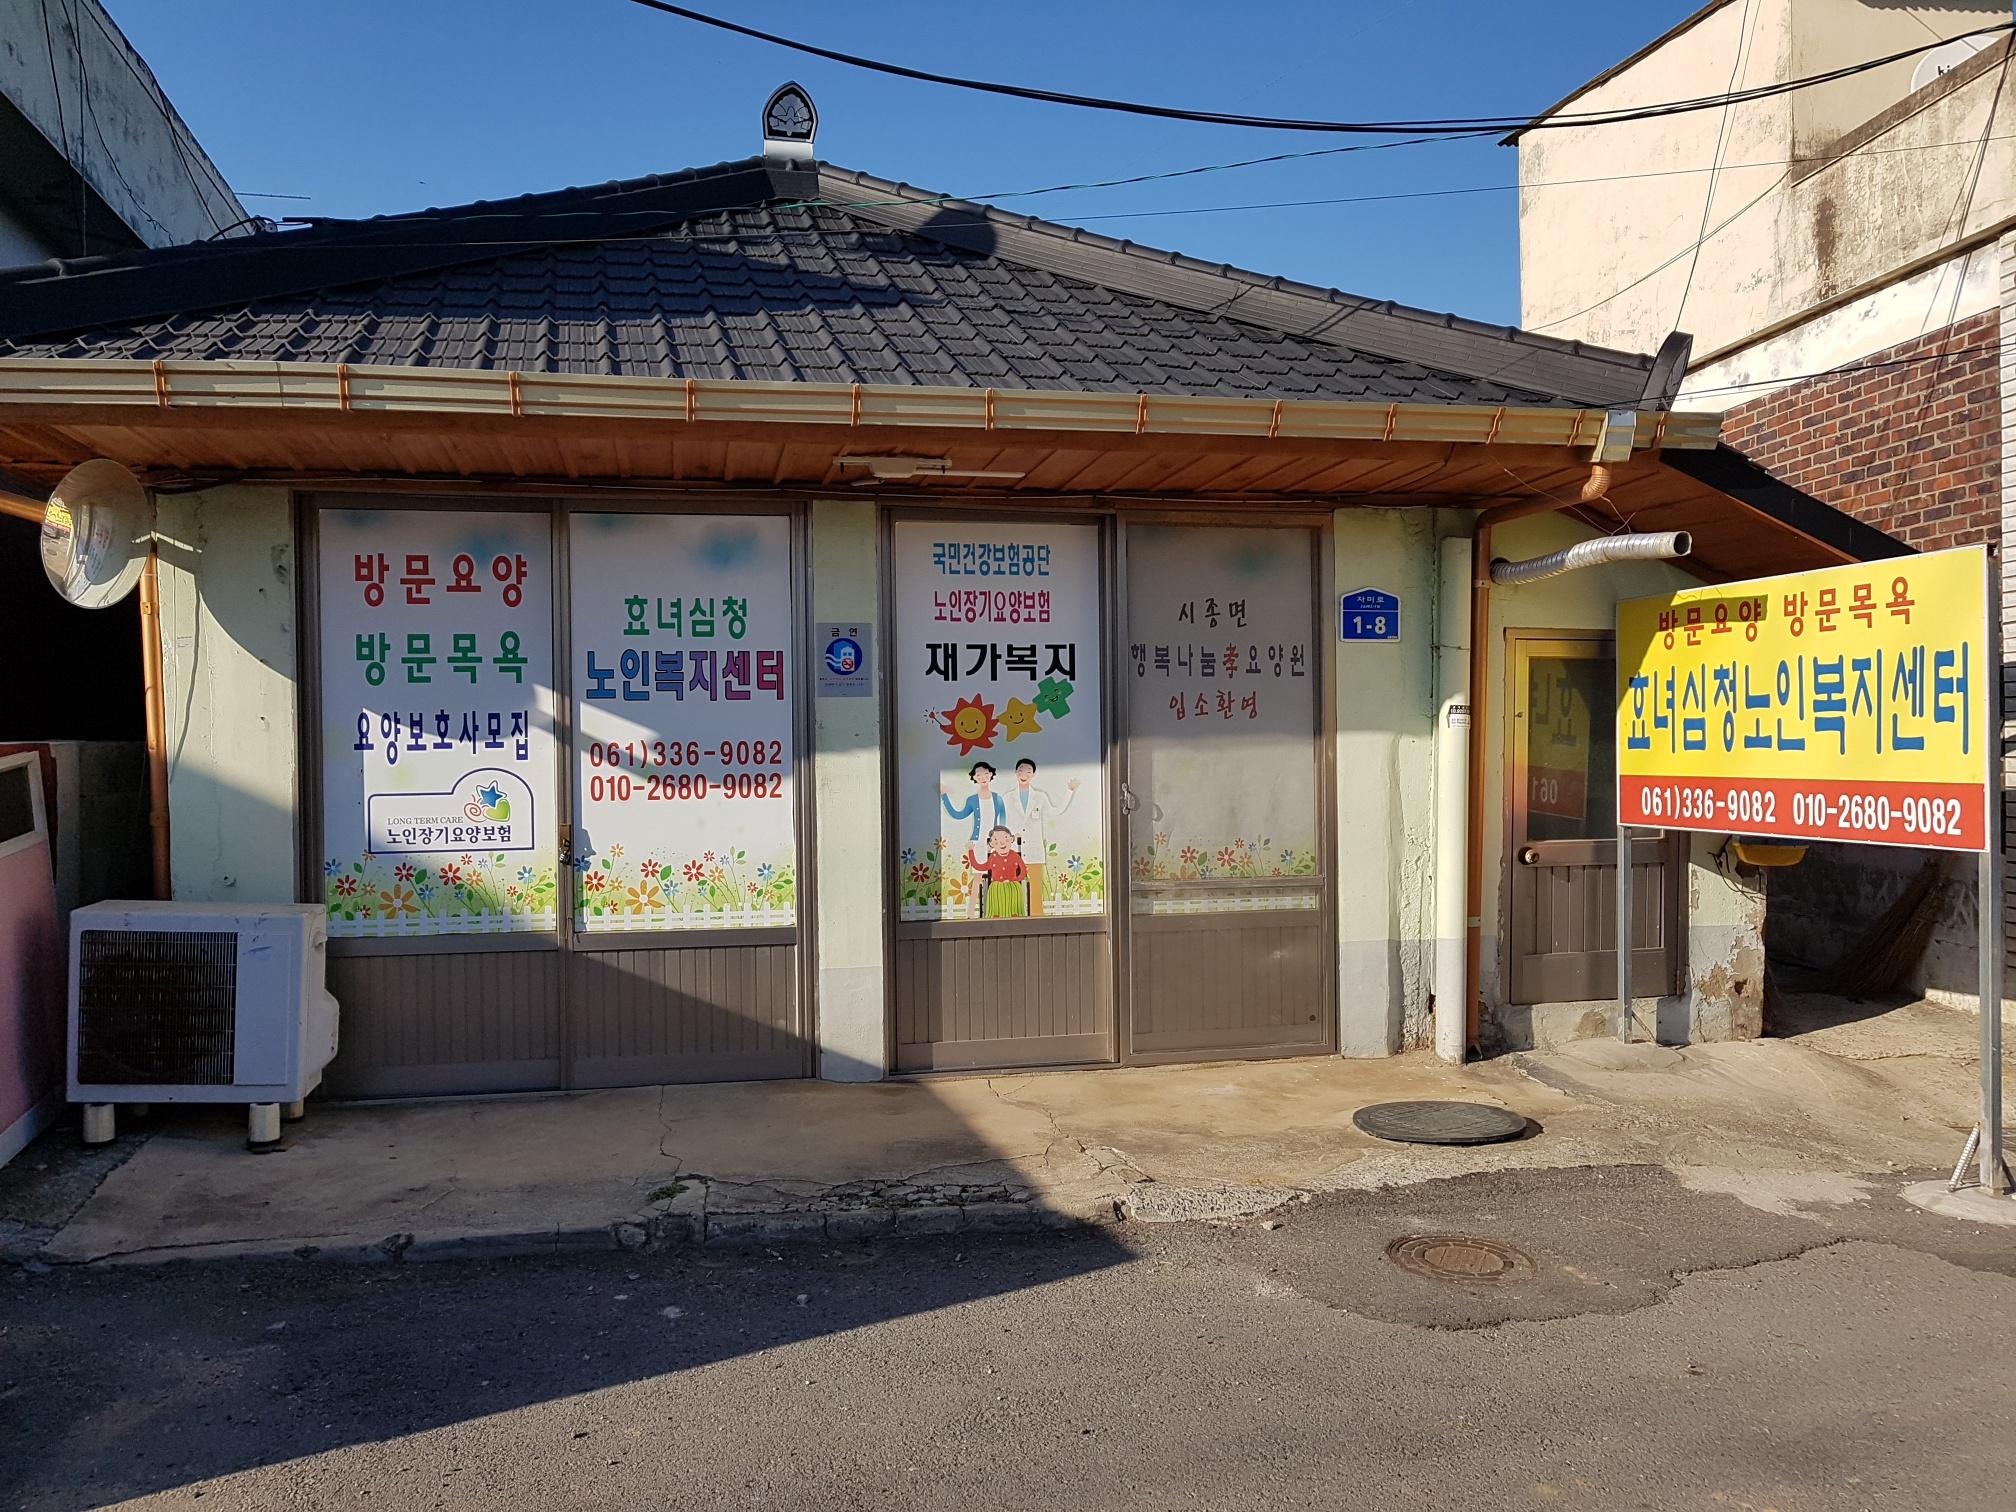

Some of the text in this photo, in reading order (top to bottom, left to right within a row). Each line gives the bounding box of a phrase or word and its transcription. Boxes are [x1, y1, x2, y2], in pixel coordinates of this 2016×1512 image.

[932, 541, 1051, 577] 국민건강보험공단
[354, 554, 528, 607] 방문요양
[623, 595, 749, 640] 효녀심청
[933, 589, 1051, 625] 노인장기요양보험
[1178, 597, 1248, 628] 시종면
[1356, 596, 1385, 604] 자미로
[1658, 576, 1916, 651] 방문요양 방문목욕
[1353, 615, 1386, 634] 1-8
[355, 631, 529, 687] 방문목욕
[586, 649, 784, 701] 노인복지센터
[925, 642, 1077, 682] 재가복지
[1169, 690, 1258, 721] 입소환영
[1626, 641, 1970, 755] 효녀심청노인복지센터
[353, 710, 529, 765] 요양보호사모집
[589, 740, 783, 769] 061)336-9082
[589, 773, 783, 802] 010-2680-9082
[387, 816, 464, 826] LONG TERM CARE
[1640, 785, 1963, 837] 061)336-9082 010-2680-9082
[386, 825, 512, 846] 노인장기요양보험
